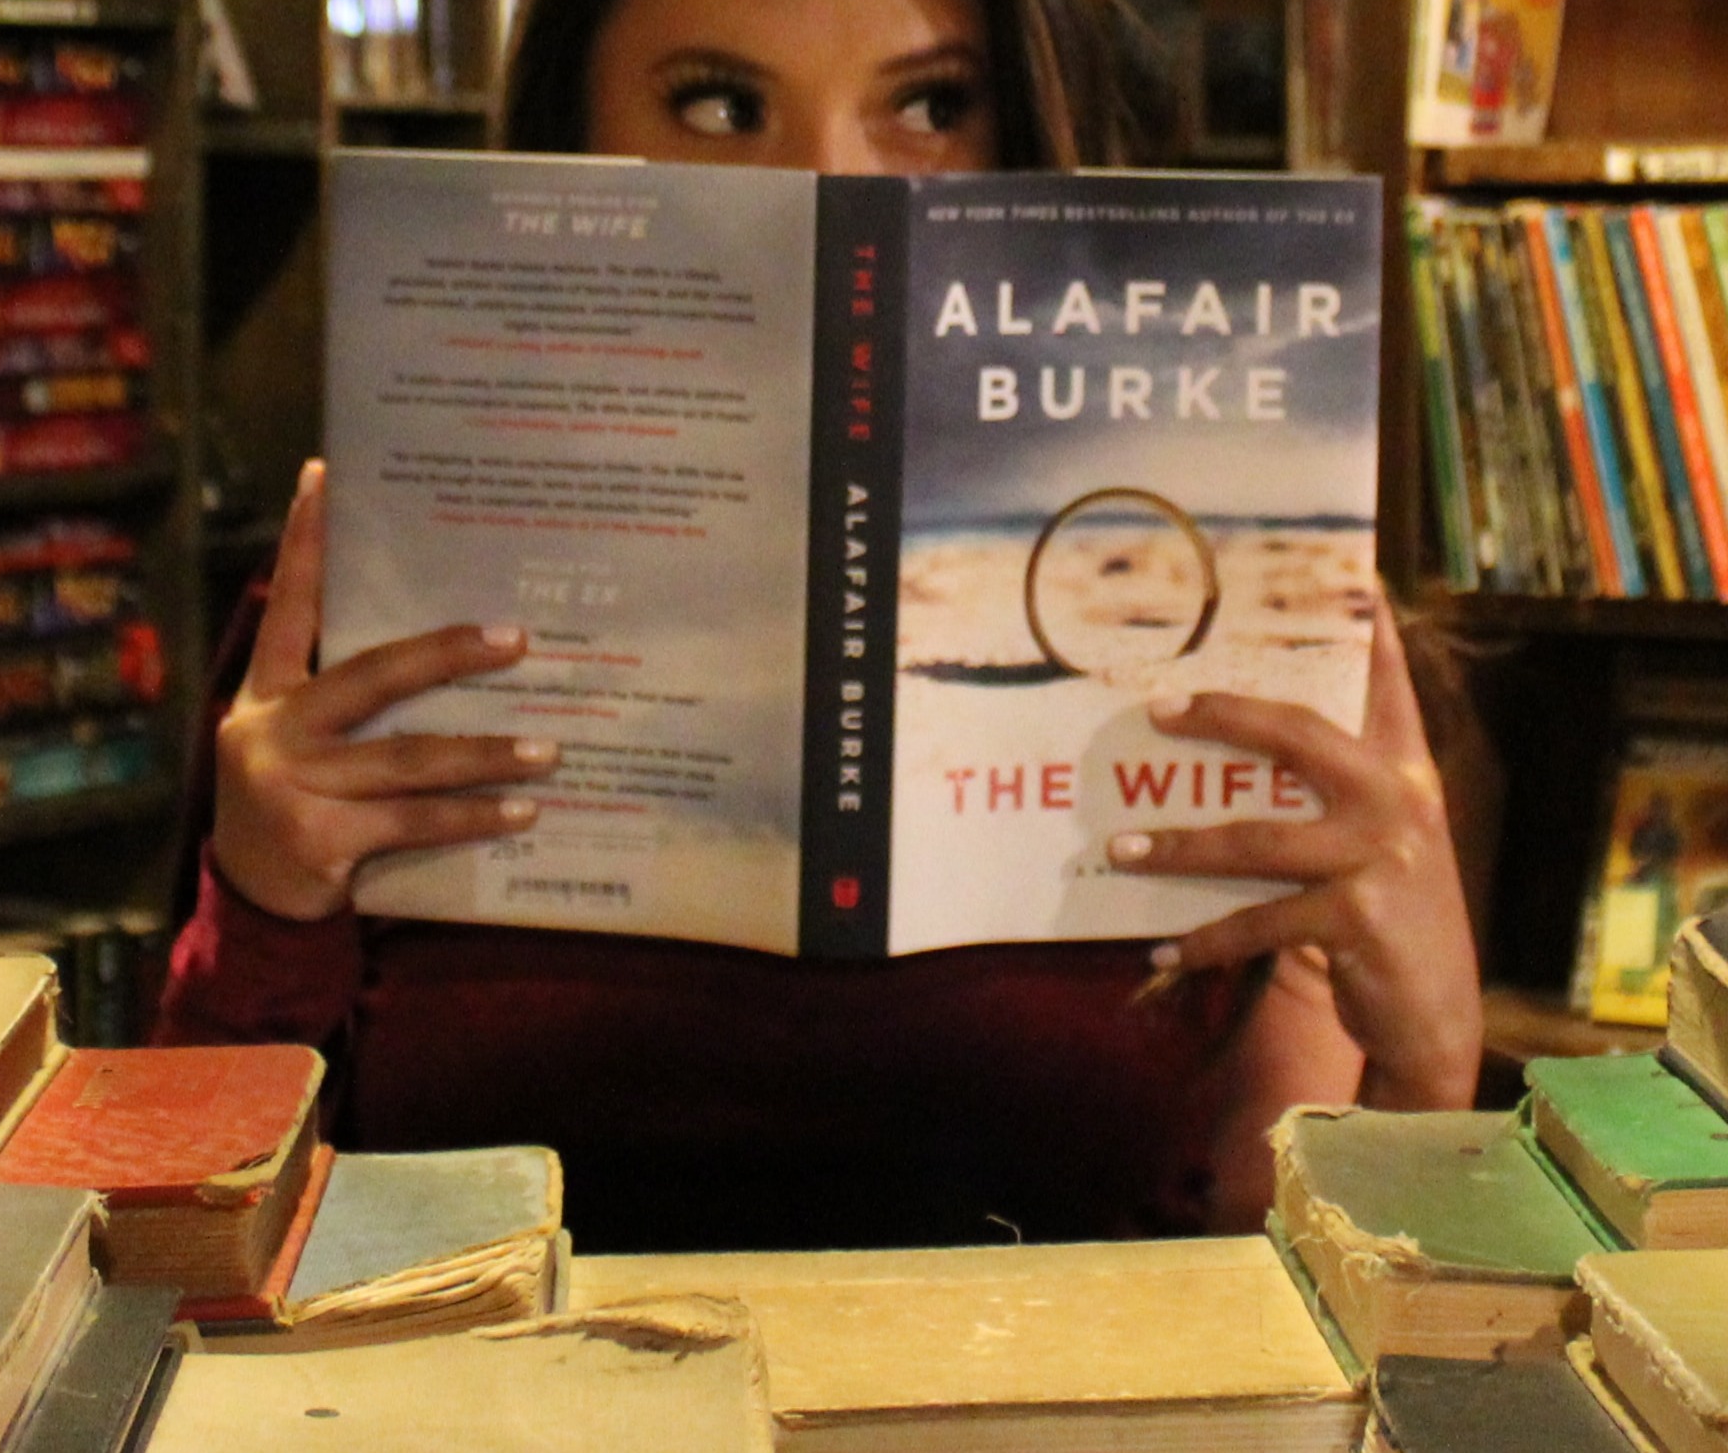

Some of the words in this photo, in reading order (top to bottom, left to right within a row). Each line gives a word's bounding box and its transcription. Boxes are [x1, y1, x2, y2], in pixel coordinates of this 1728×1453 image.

[504, 211, 559, 235] THE
[571, 213, 650, 240] WIFE
[852, 246, 876, 317] THE
[934, 280, 1343, 339] ALAFAIR
[849, 344, 872, 442] WIFE
[977, 365, 1288, 423] BURKE
[841, 483, 869, 660] ALAFAIR
[837, 682, 864, 814] BURKE
[943, 761, 1075, 813] THE
[1113, 758, 1308, 809] WIFE
